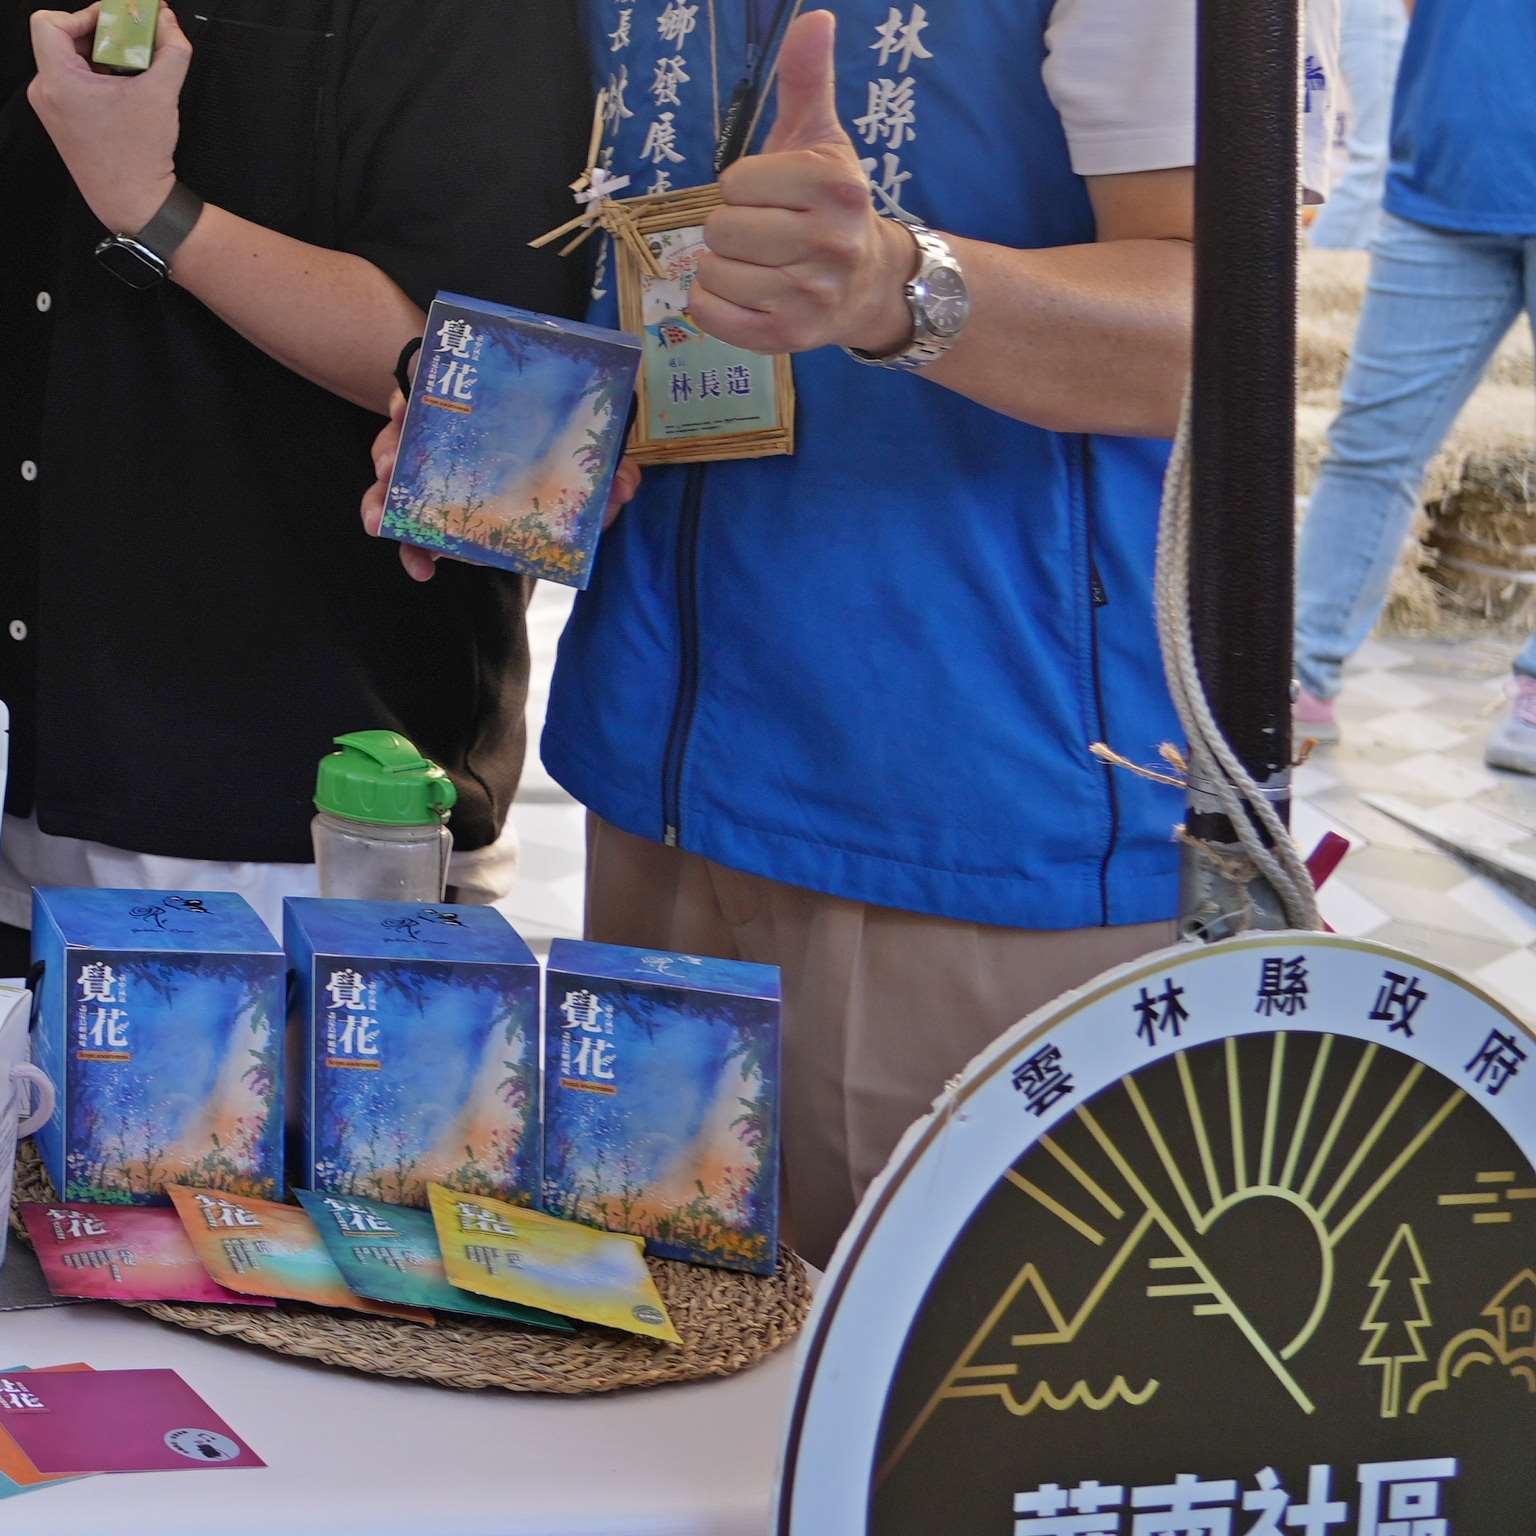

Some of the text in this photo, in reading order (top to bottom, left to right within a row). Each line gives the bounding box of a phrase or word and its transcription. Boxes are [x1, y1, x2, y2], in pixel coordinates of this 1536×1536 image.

[670, 365, 753, 403] 林長造
[1011, 953, 1528, 1116] 雲林縣政府
